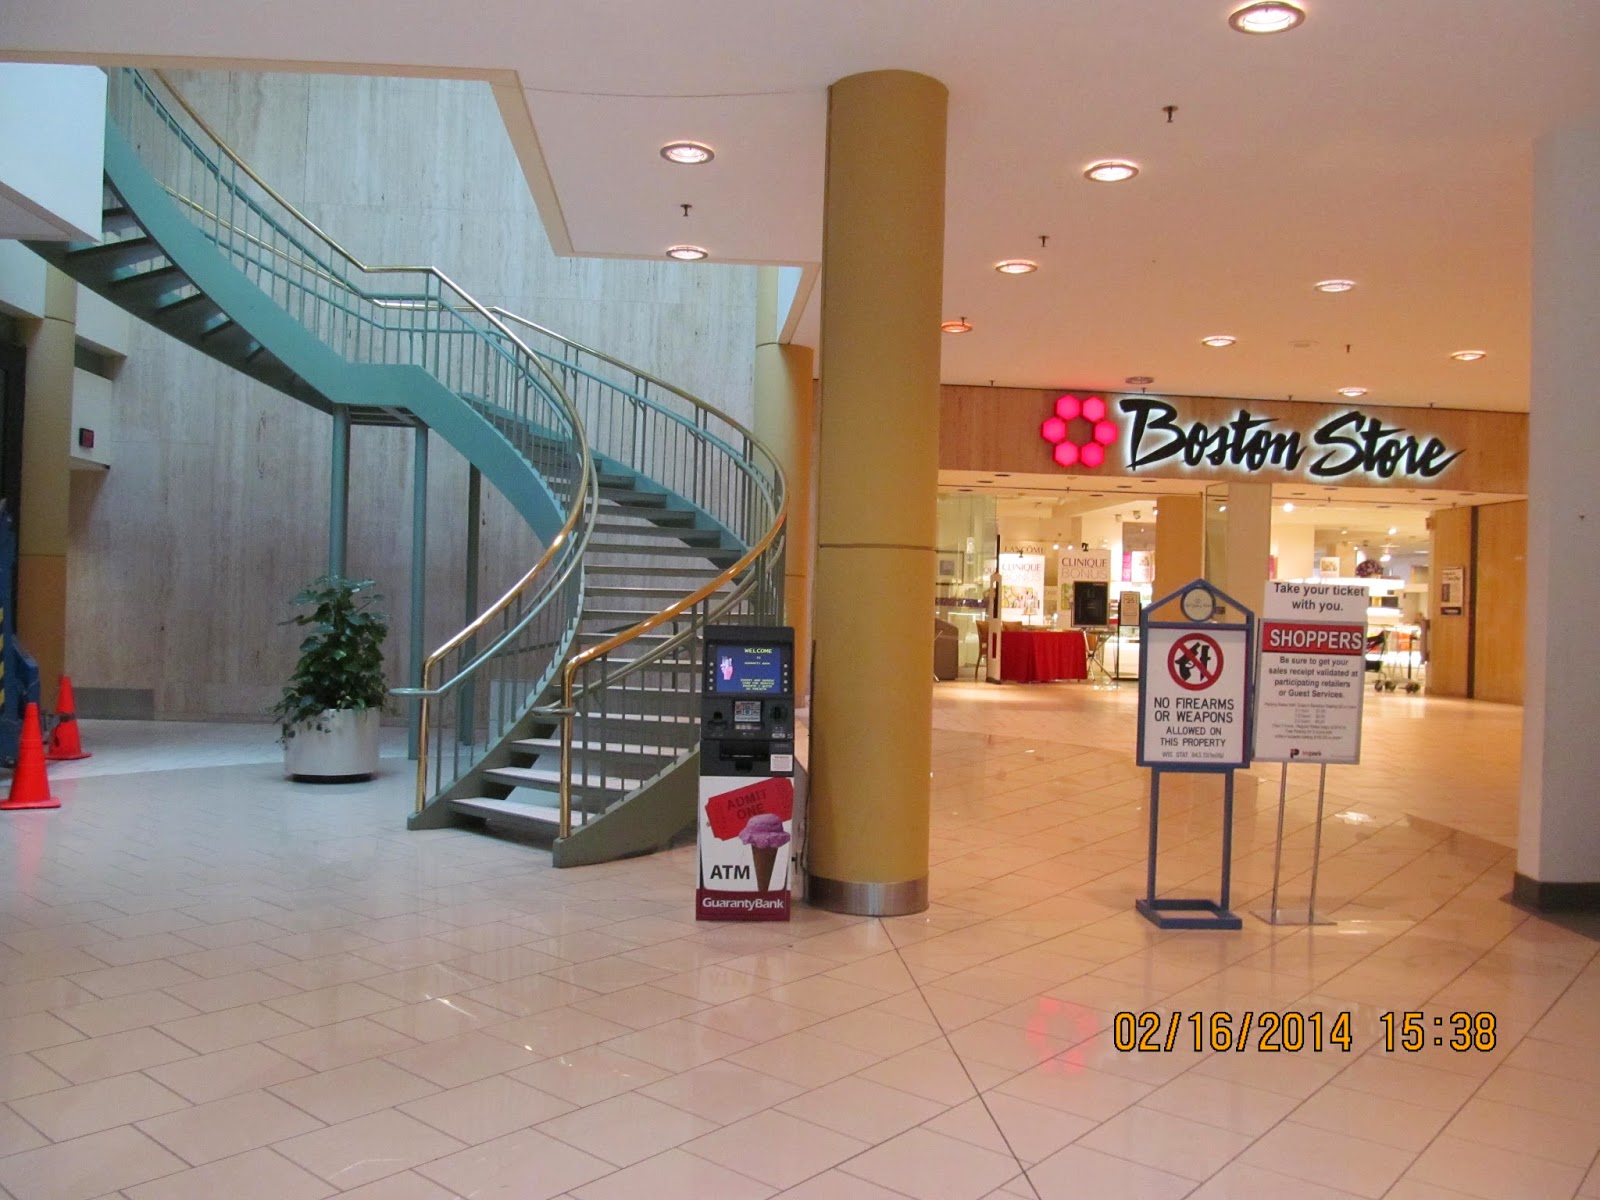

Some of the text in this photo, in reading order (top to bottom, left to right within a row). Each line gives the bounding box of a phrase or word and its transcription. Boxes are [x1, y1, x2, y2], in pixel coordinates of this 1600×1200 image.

[1119, 398, 1467, 478] Boston Store
[1002, 563, 1041, 572] CLINIQUE
[1061, 557, 1107, 568] CLINIQUE
[1061, 568, 1108, 579] BONUS
[1274, 582, 1365, 597] Take your ticket
[1292, 599, 1344, 613] with you.
[1270, 628, 1362, 650] SHOPPERS
[1279, 656, 1290, 664] Be
[1309, 657, 1317, 665] to
[1318, 659, 1331, 667] get
[1268, 667, 1288, 675] sales
[1289, 668, 1315, 676] receipt
[1316, 669, 1350, 677] validated
[1274, 678, 1351, 689] participating retailers
[1288, 689, 1310, 697] Guest
[1153, 697, 1235, 710] NO FIREARMS
[1154, 710, 1233, 724] OR WEAPONS
[1166, 726, 1222, 736] ALLOWED ON
[1160, 737, 1227, 747] THIS PROPERTY
[727, 788, 767, 811] ADMIT
[737, 803, 766, 819] ONE
[710, 864, 751, 880] ATM
[702, 897, 785, 911] GuarantyBank
